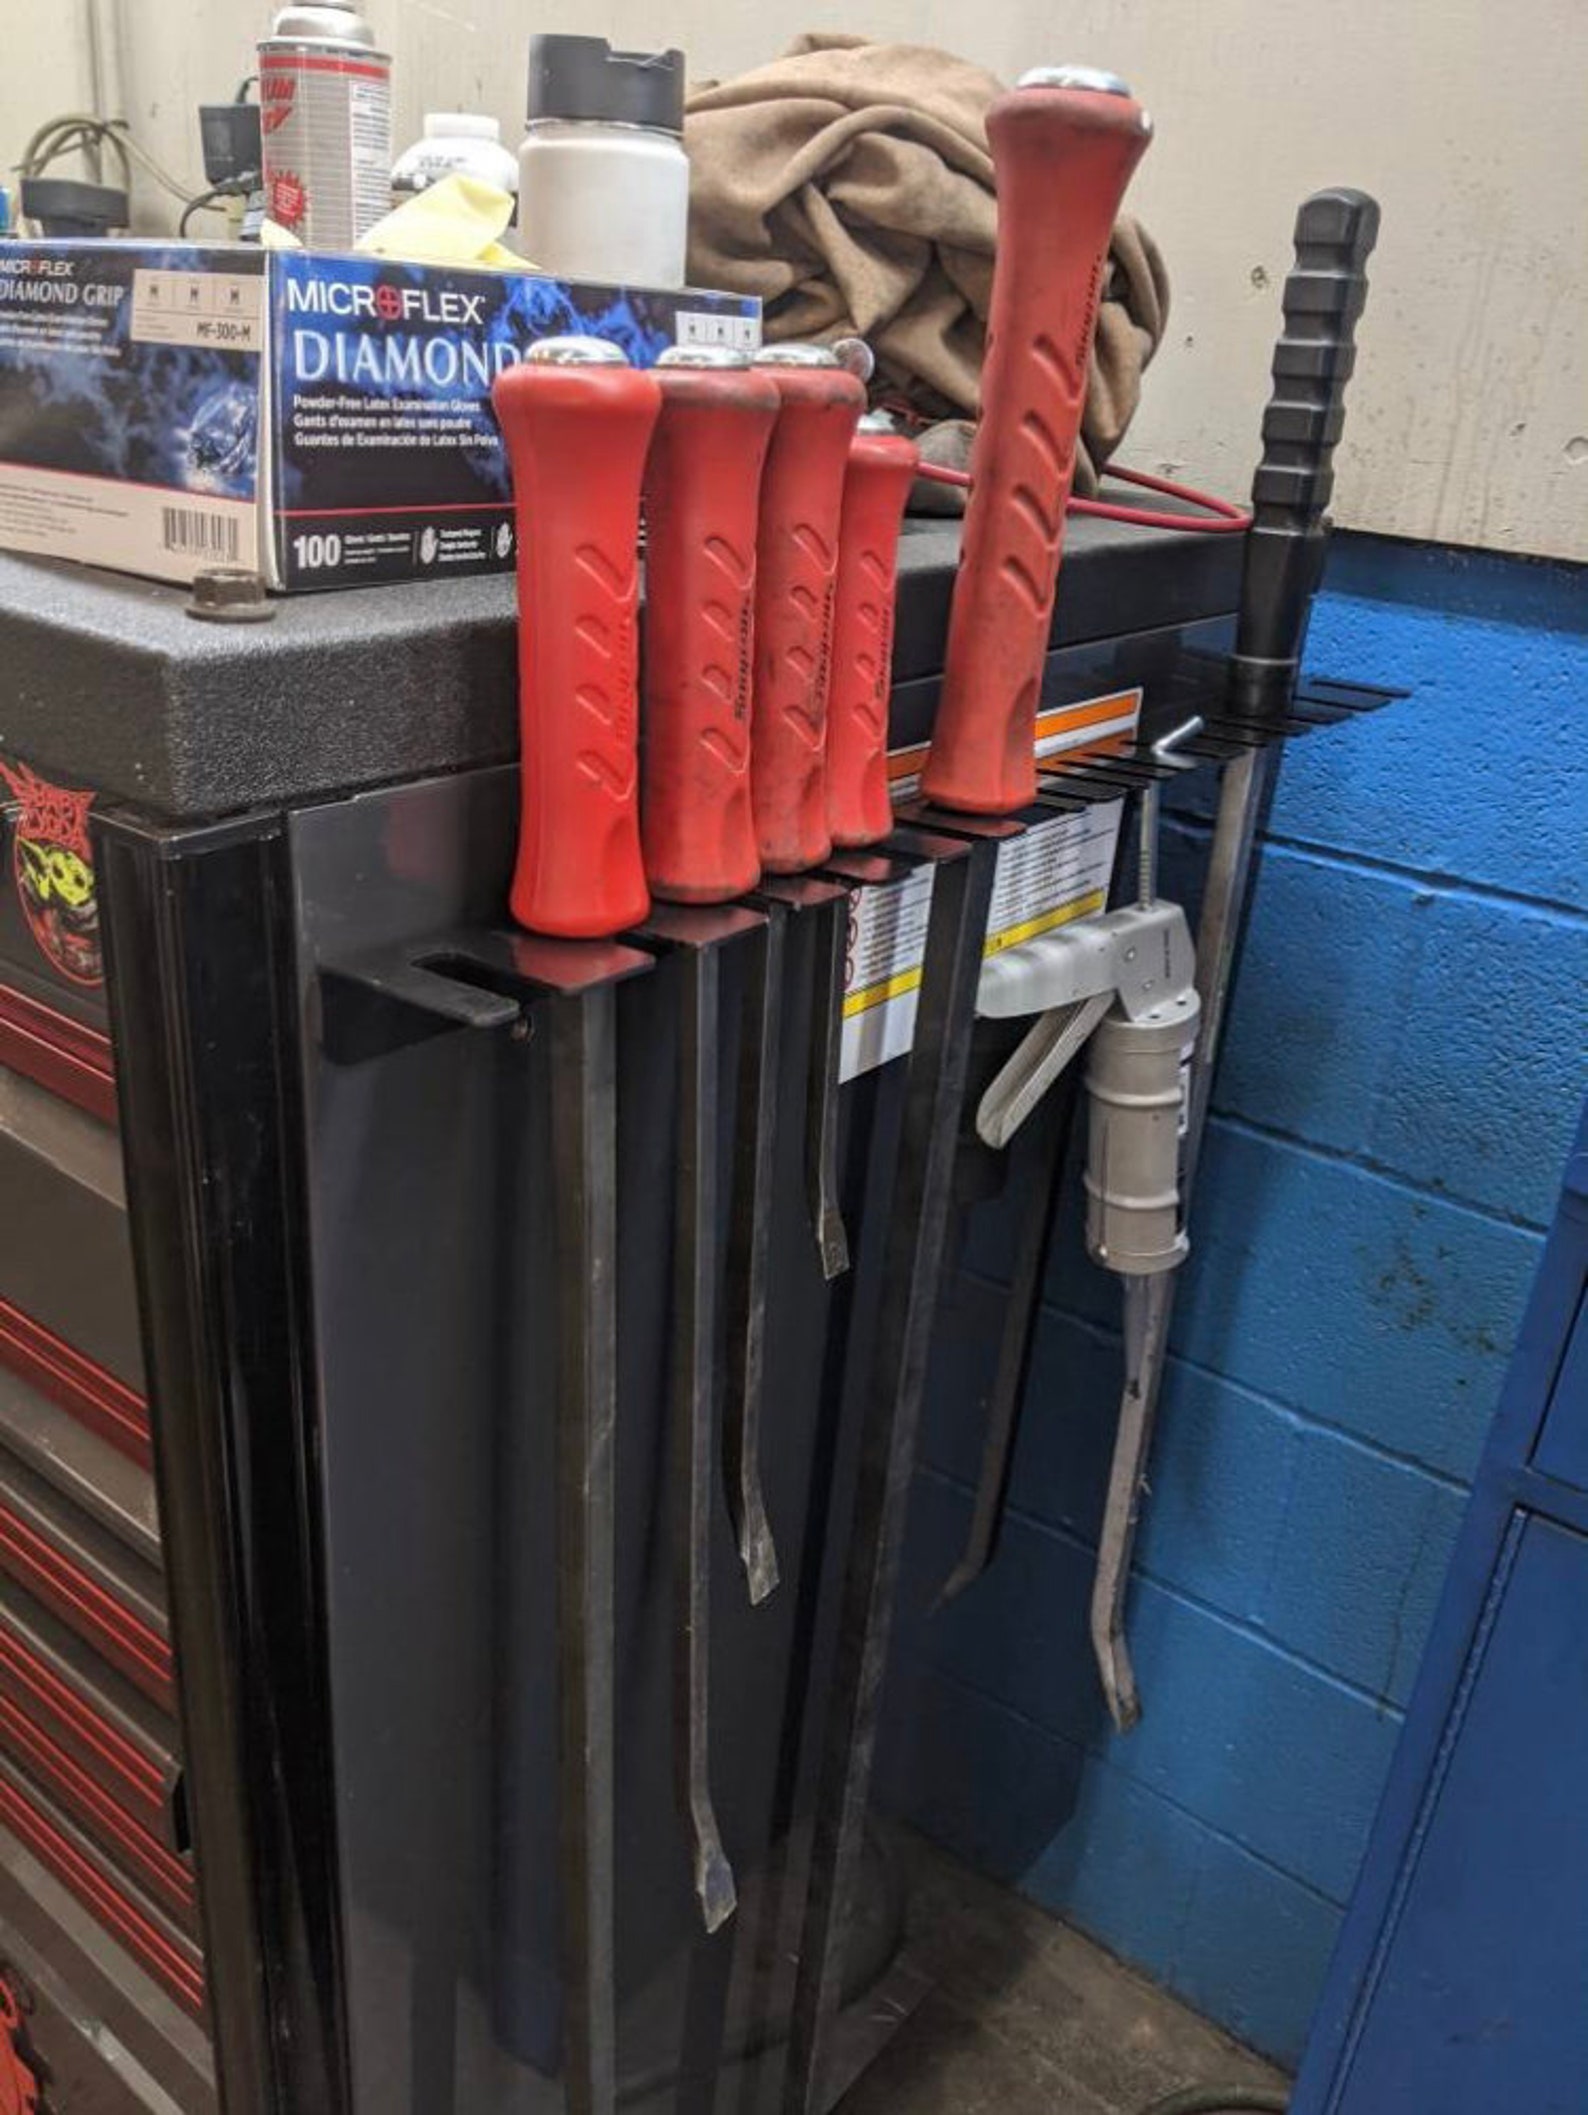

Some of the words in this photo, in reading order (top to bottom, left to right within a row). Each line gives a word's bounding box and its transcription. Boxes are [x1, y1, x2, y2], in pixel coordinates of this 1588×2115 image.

[0, 258, 76, 277] MICROFLEX
[0, 278, 79, 304] DIAMOND
[82, 282, 124, 306] GRIP
[287, 278, 484, 324] MICROFLEX
[293, 533, 341, 569] 100
